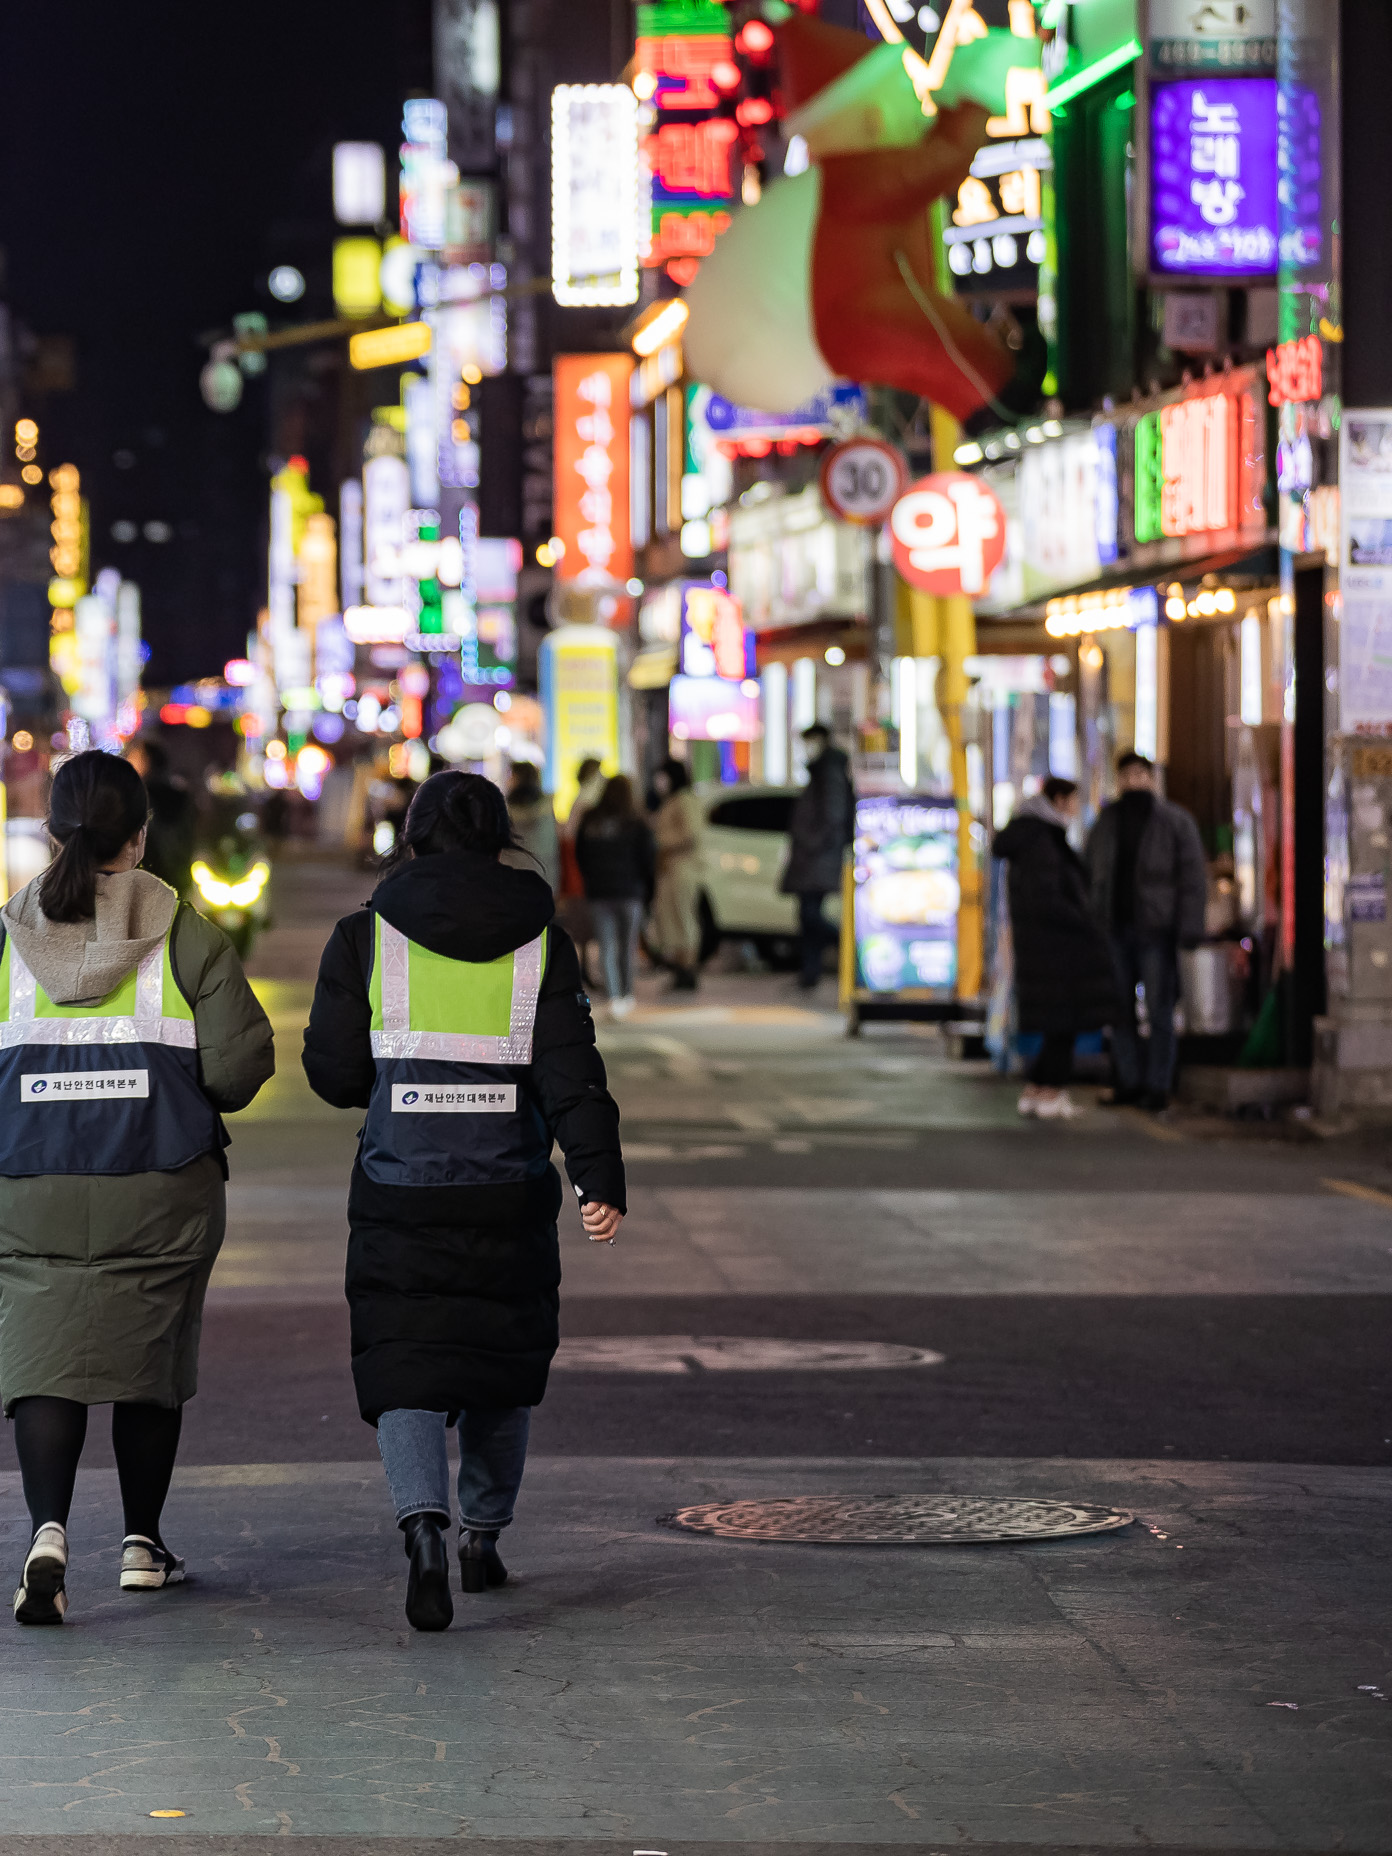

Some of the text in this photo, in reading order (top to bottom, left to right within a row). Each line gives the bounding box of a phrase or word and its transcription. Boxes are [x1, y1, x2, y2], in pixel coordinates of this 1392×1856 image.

[1190, 90, 1246, 226] 노래방
[839, 460, 885, 502] 30
[892, 480, 998, 595] 약
[52, 1078, 138, 1091] 재난안전대책본부
[424, 1092, 507, 1104] 재난안전대책본부
